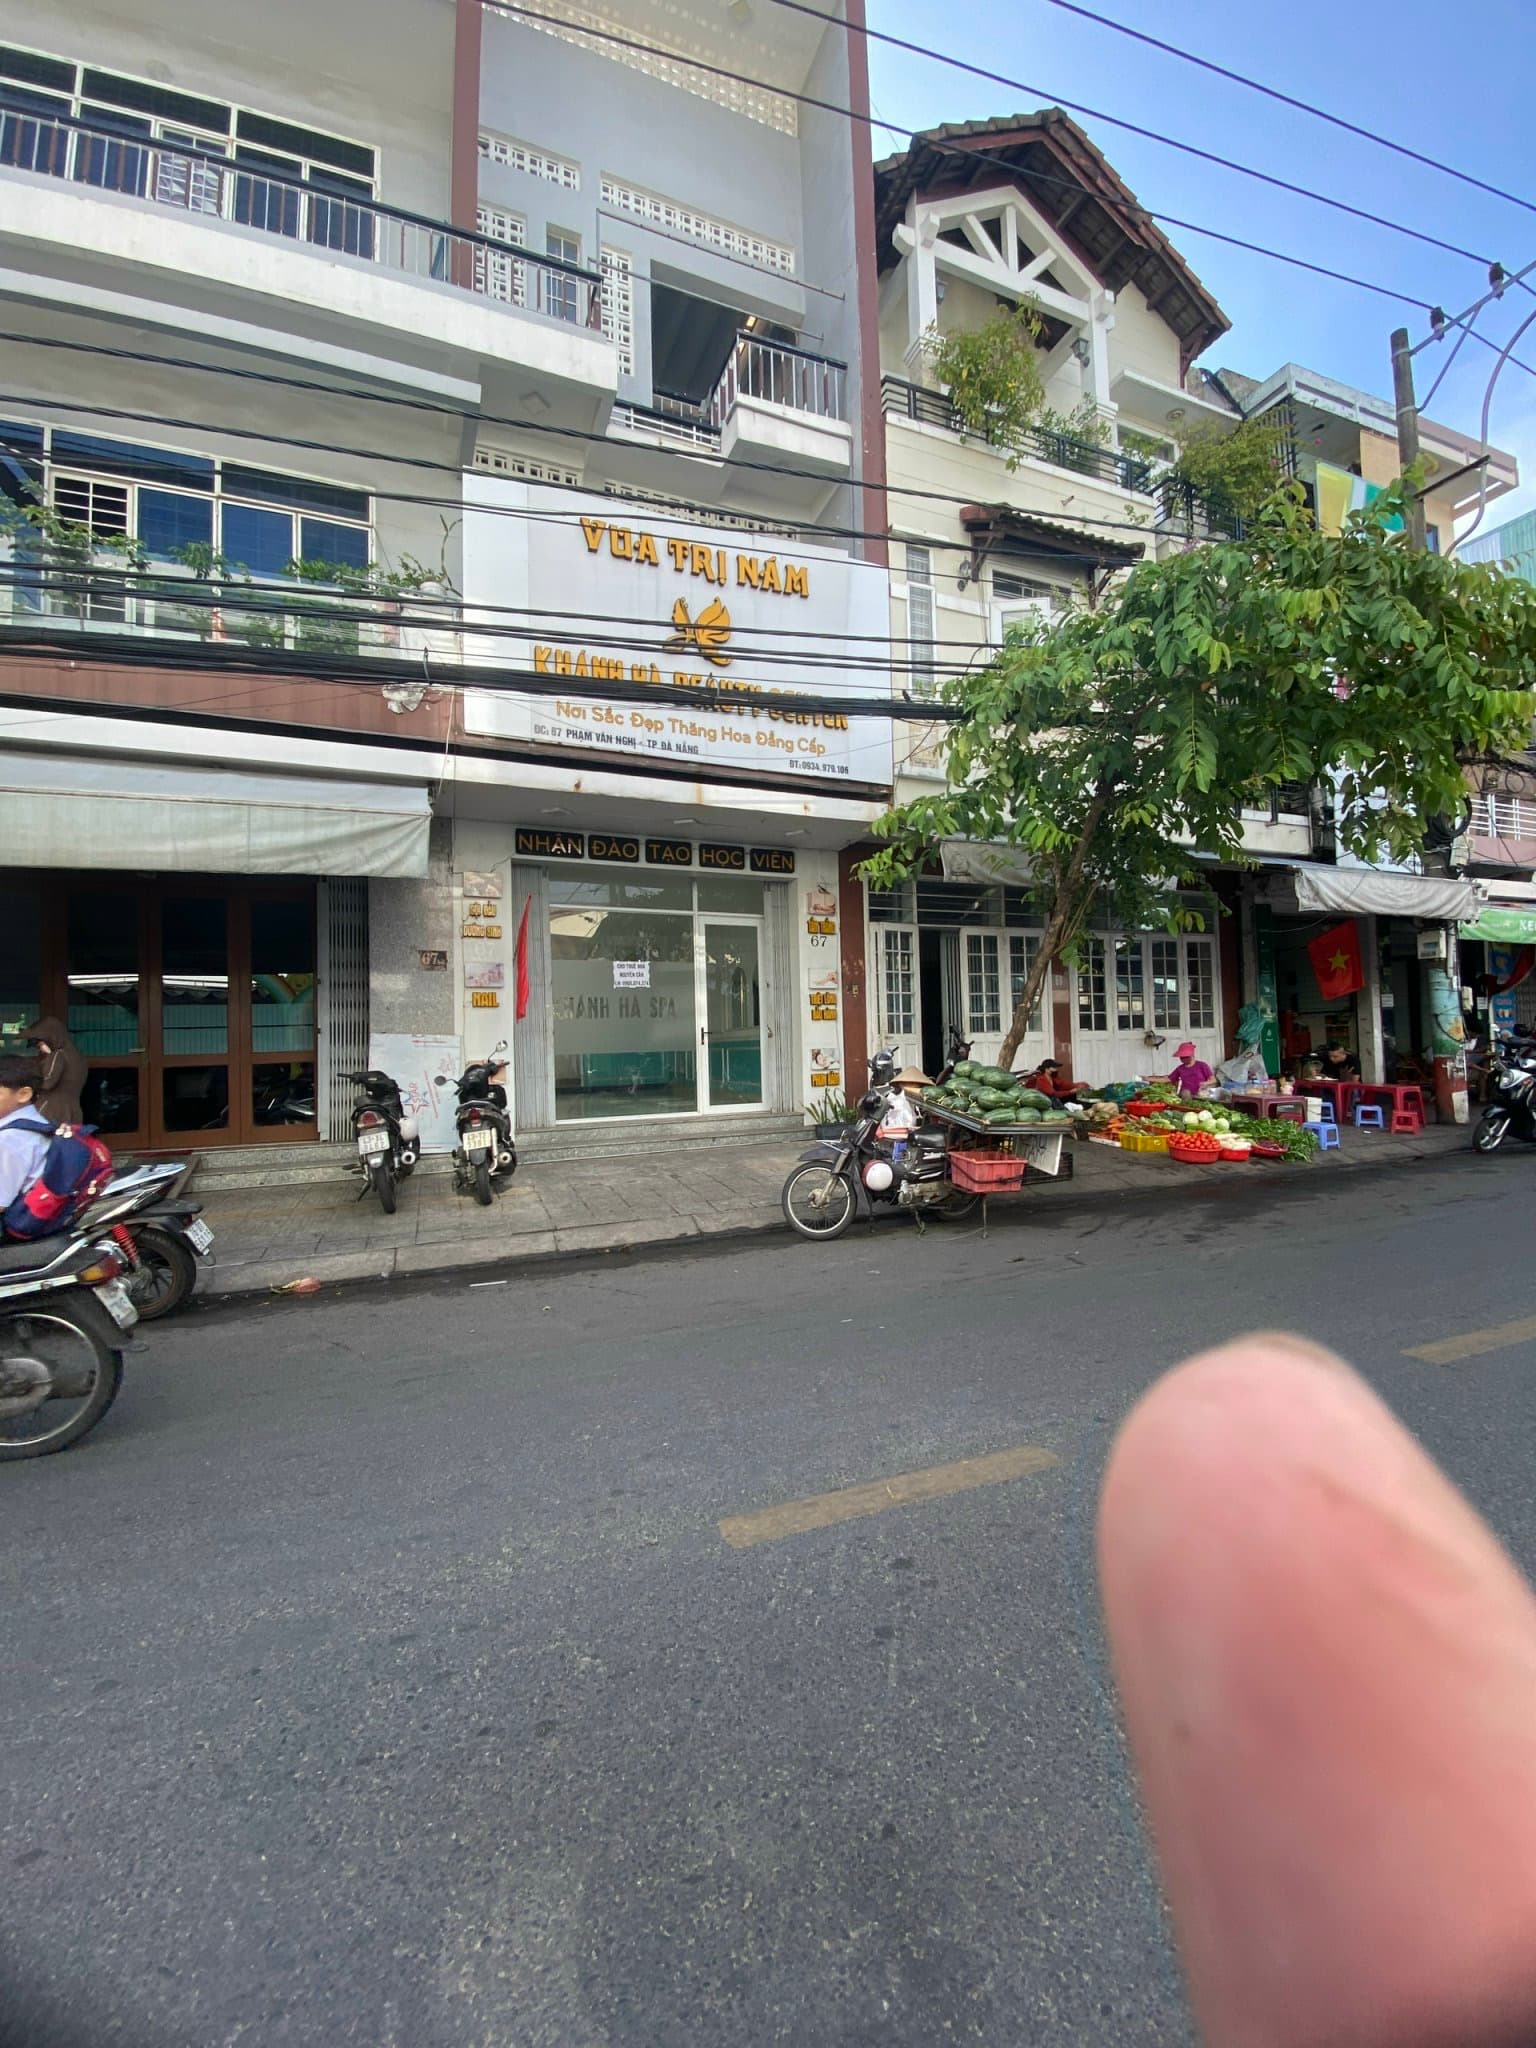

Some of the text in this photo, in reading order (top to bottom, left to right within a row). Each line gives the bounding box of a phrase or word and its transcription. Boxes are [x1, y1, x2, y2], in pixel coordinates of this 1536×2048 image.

[668, 537, 727, 586] TRỊ
[737, 555, 810, 598] NÁM
[566, 729, 592, 742] PHẠM
[592, 705, 624, 725] Sắc
[630, 712, 664, 734] Đẹp
[668, 718, 717, 742] Thăng
[721, 726, 751, 744] Hoa
[797, 736, 825, 757] Cấp
[519, 833, 793, 870] NHẬN ĐÀO TẠO HỌC VIÊN
[811, 935, 827, 947] 67
